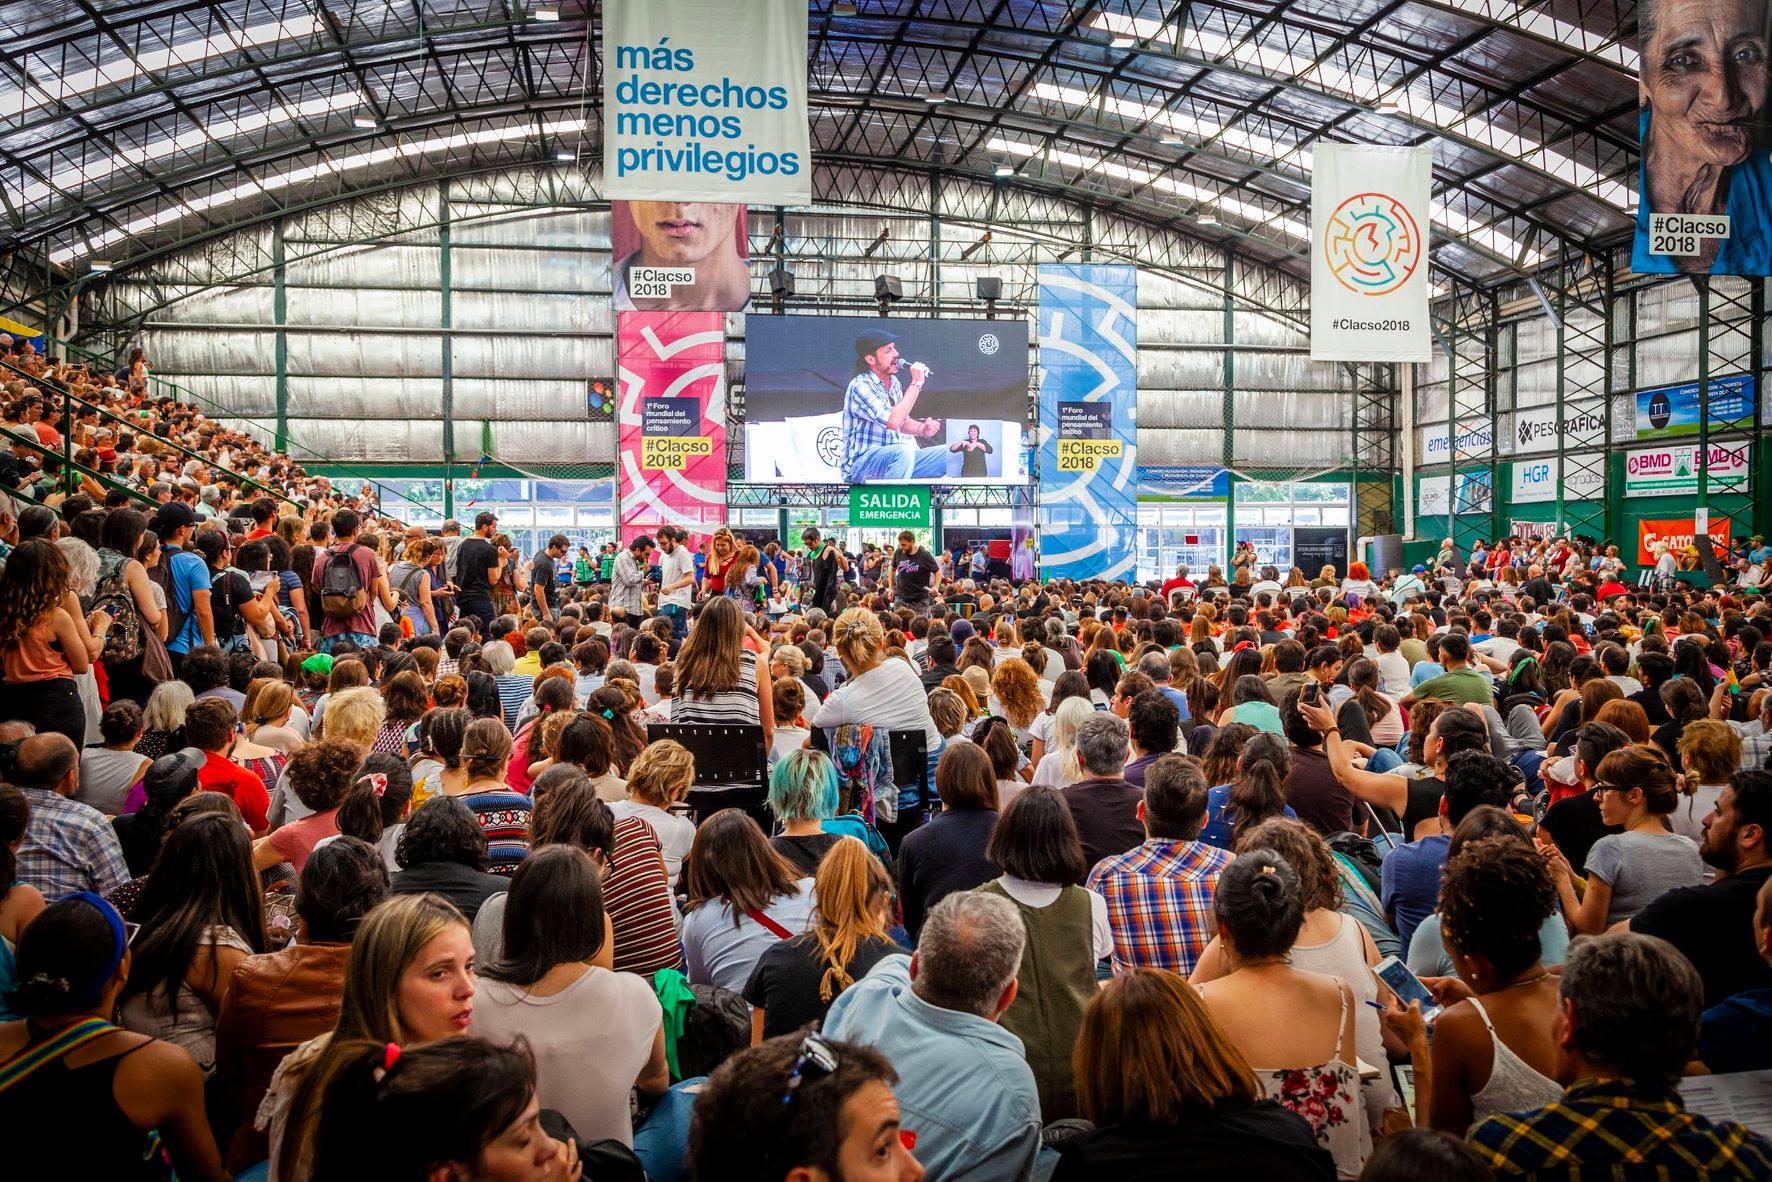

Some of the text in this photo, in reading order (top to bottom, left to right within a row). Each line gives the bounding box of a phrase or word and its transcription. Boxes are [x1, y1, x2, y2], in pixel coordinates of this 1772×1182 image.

[616, 37, 694, 71] más
[616, 74, 788, 109] derechos
[617, 110, 742, 139] menos
[617, 142, 800, 182] privilegios
[1654, 216, 1727, 235] #Clacso
[1654, 236, 1695, 253] 2018
[633, 269, 692, 282] #Clacso
[634, 283, 667, 296] 2018
[1332, 318, 1410, 331] #Clacso2018
[646, 439, 709, 453] #Clacso
[1062, 442, 1119, 455] #Clacso
[646, 454, 682, 467] 2018
[1062, 456, 1094, 469] 2018
[1639, 453, 1672, 469] BMD
[1523, 464, 1549, 483] HGR
[860, 494, 921, 508] SALIDA
[860, 511, 921, 519] EMERGENCIA
